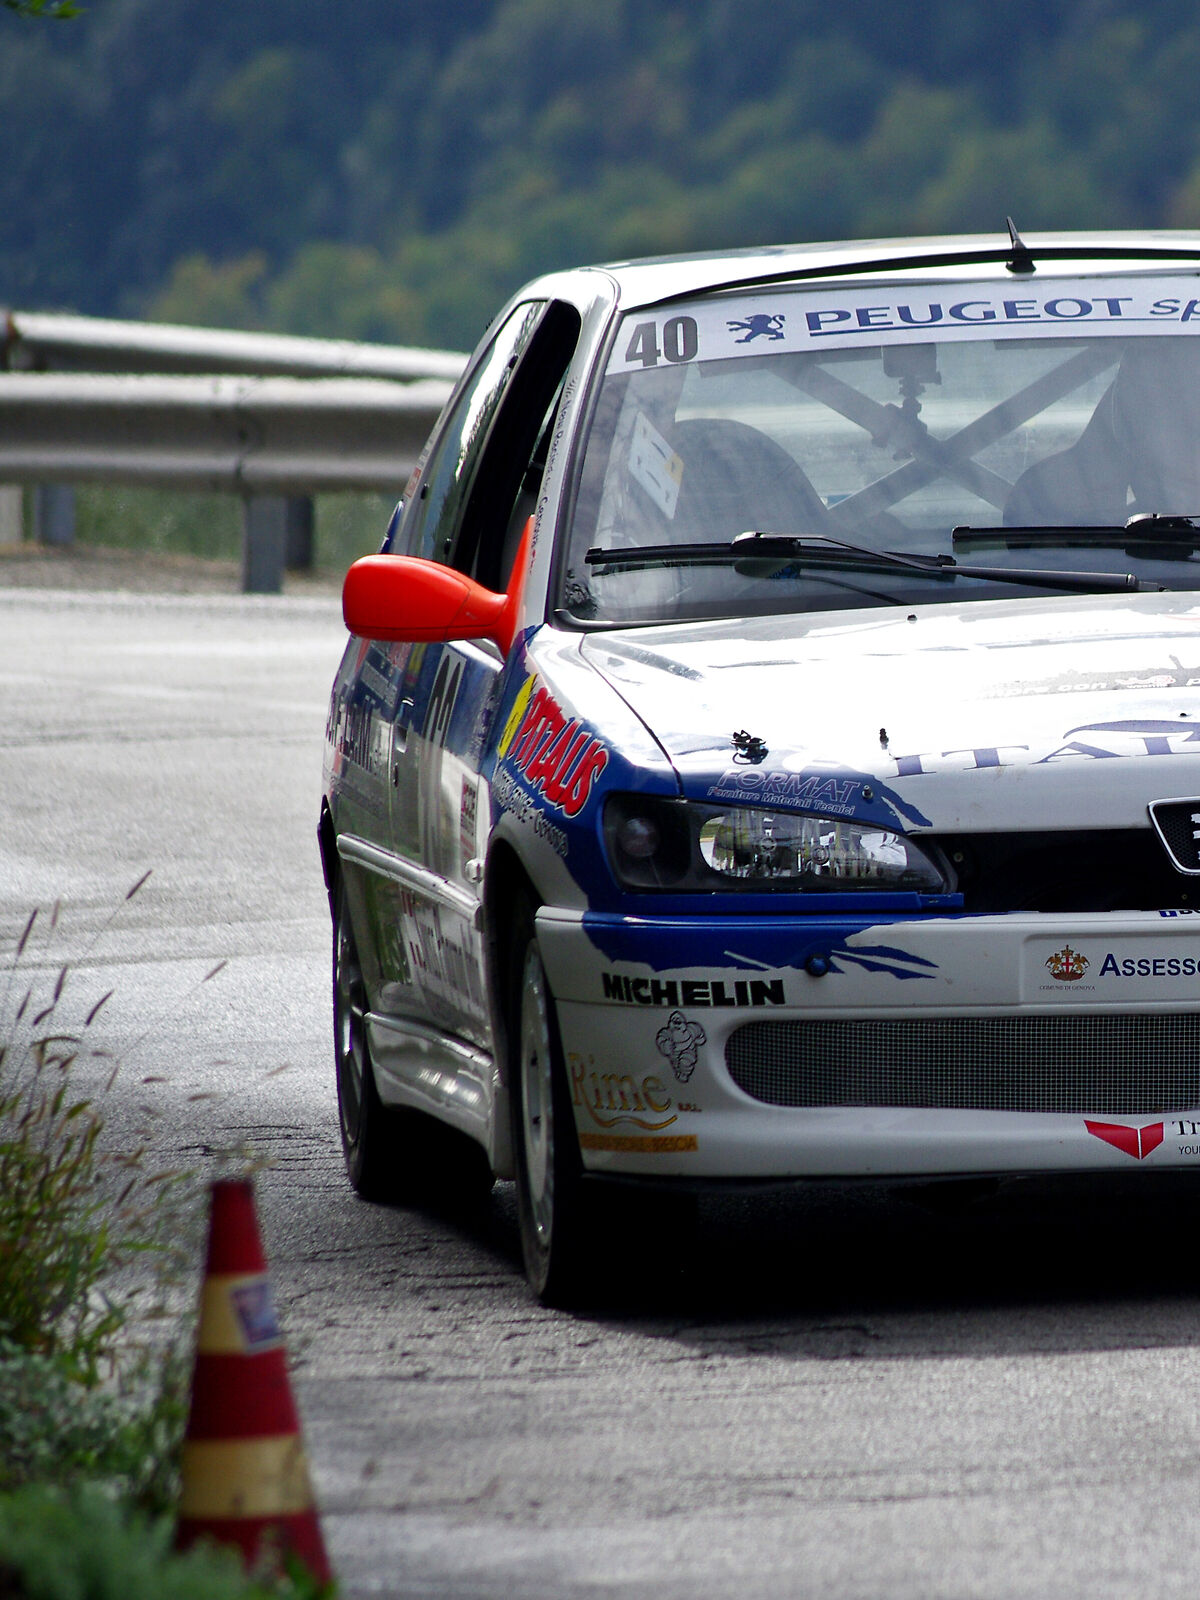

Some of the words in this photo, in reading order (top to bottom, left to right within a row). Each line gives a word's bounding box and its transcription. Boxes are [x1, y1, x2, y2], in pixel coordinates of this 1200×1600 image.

[805, 297, 1133, 331] PEUGEOT
[624, 316, 699, 368] 40
[717, 768, 861, 803] FORMAT
[761, 792, 812, 809] Materiali
[813, 799, 856, 816] Tecnici
[602, 972, 786, 1007] MICHELIN
[567, 1052, 678, 1131] Rime
